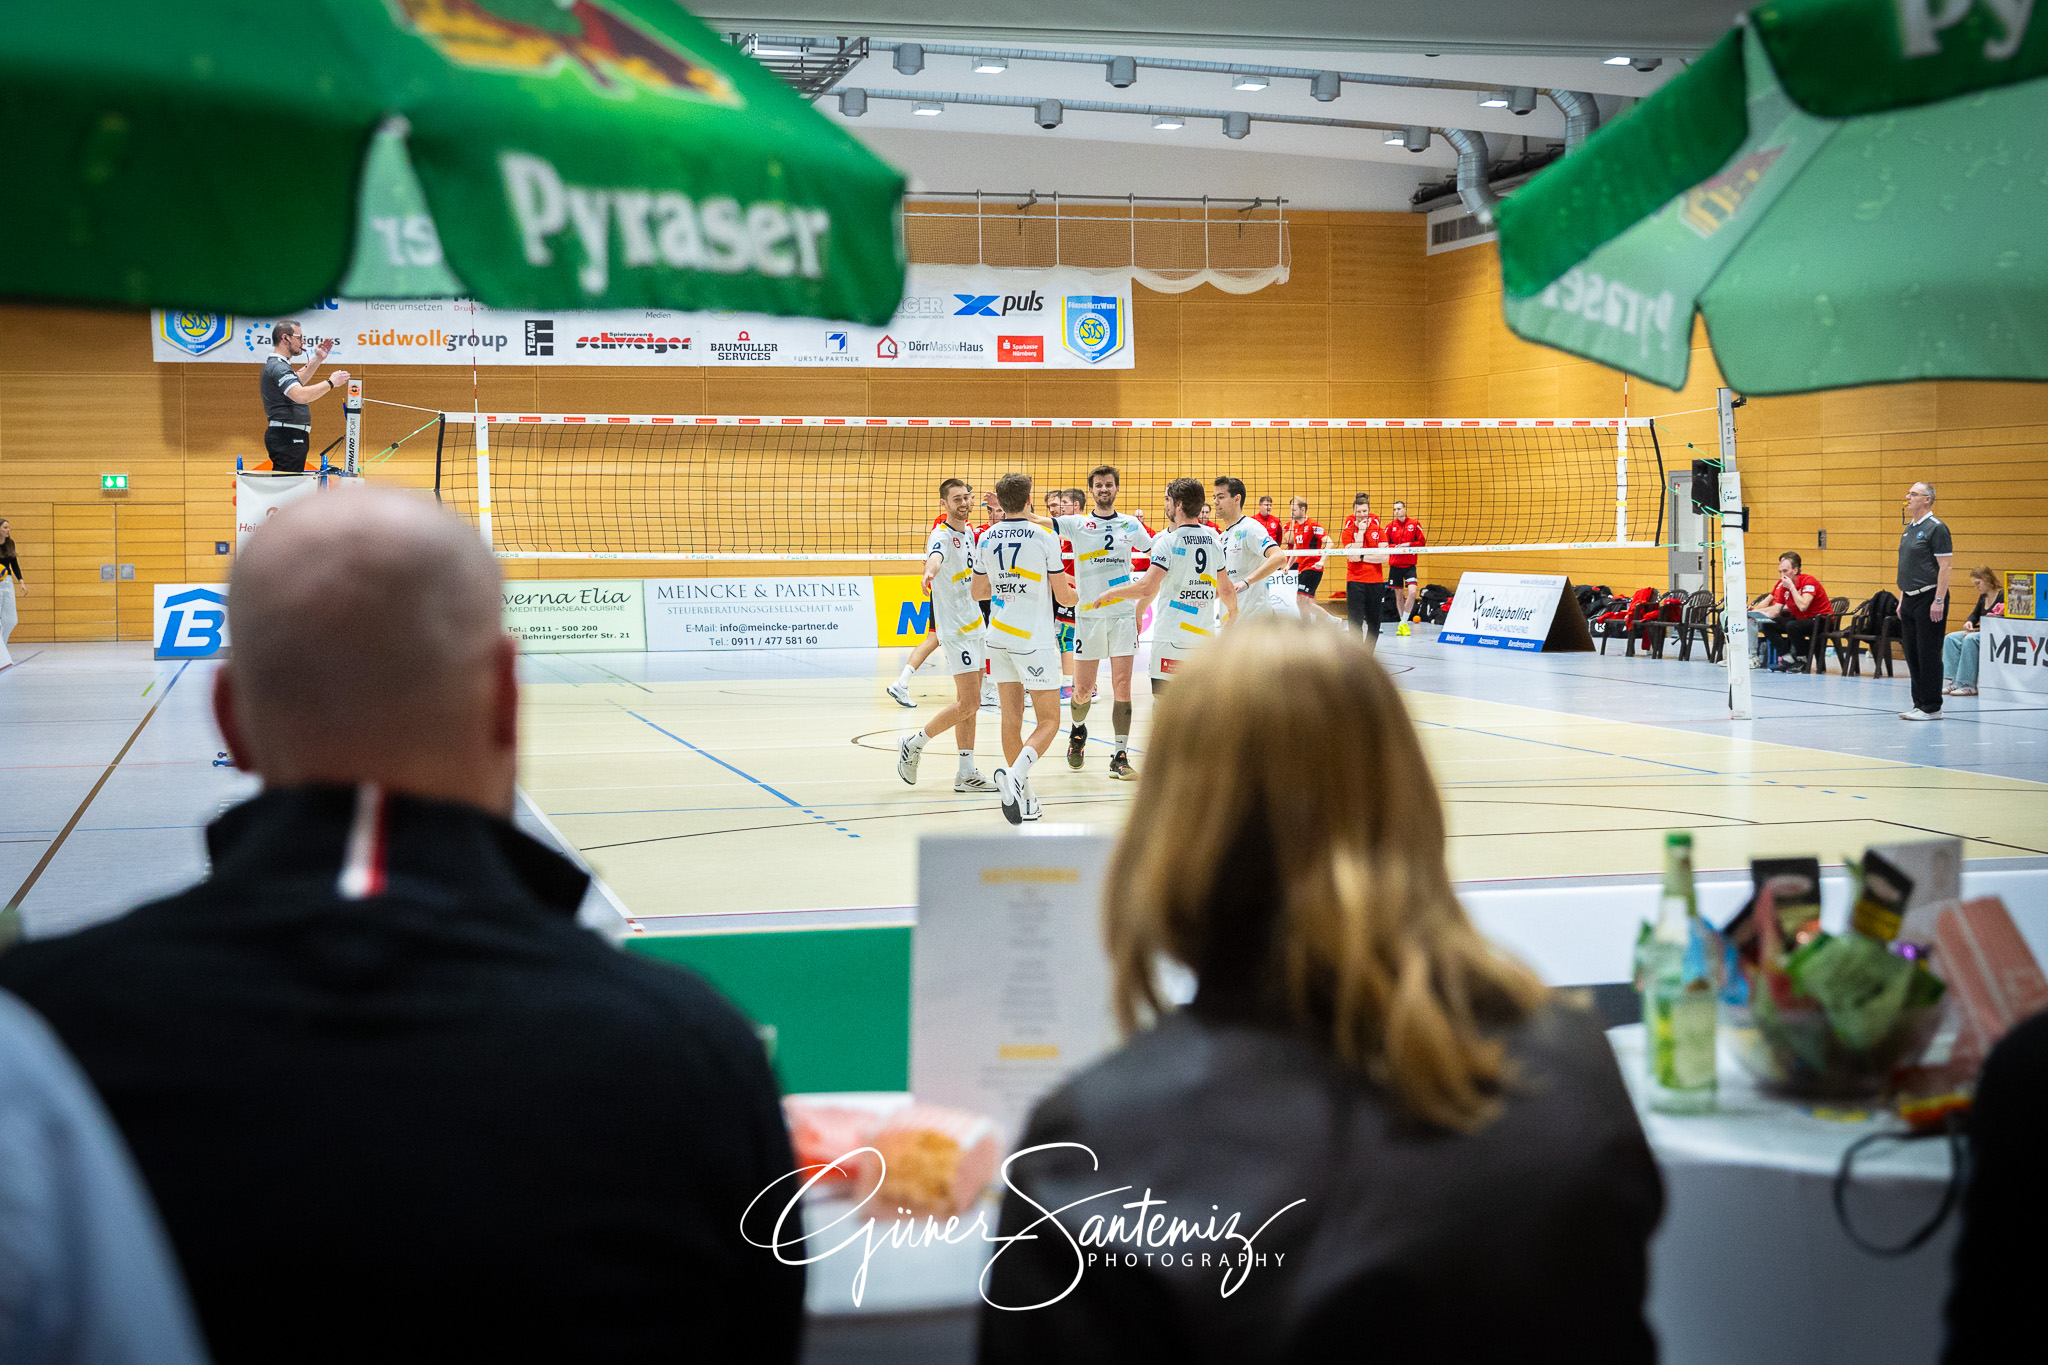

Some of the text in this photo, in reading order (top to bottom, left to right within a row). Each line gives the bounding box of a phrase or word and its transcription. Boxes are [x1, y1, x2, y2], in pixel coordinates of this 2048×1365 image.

[500, 149, 830, 294] Pyraser
[371, 302, 395, 310] Ideen
[1002, 291, 1044, 316] puls
[645, 311, 672, 319] Medien
[526, 322, 536, 354] TEAM
[576, 332, 691, 353] schweiger
[908, 341, 984, 352] DörrMassivHaus
[718, 352, 771, 361] SERVICES
[1012, 350, 1037, 358] Nürnberg
[987, 529, 1035, 540] JASTROW
[1104, 534, 1114, 551] 2
[993, 542, 1021, 571] 17
[1195, 548, 1207, 573] 9
[579, 587, 631, 604] Elia
[657, 583, 861, 600] MEINCKE & PARTNER
[1179, 590, 1209, 599] SPECK
[667, 605, 831, 615] STEUERBERATUNGSGESELLSCHAFT
[686, 622, 839, 633] E-Mail: info@meincke-partner.de
[709, 637, 729, 646] Tel.:
[731, 637, 755, 645] 0911
[764, 637, 782, 645] 477
[785, 637, 802, 645] 581
[805, 636, 817, 644] 60
[1075, 639, 1082, 653] 2
[961, 651, 971, 665] 6
